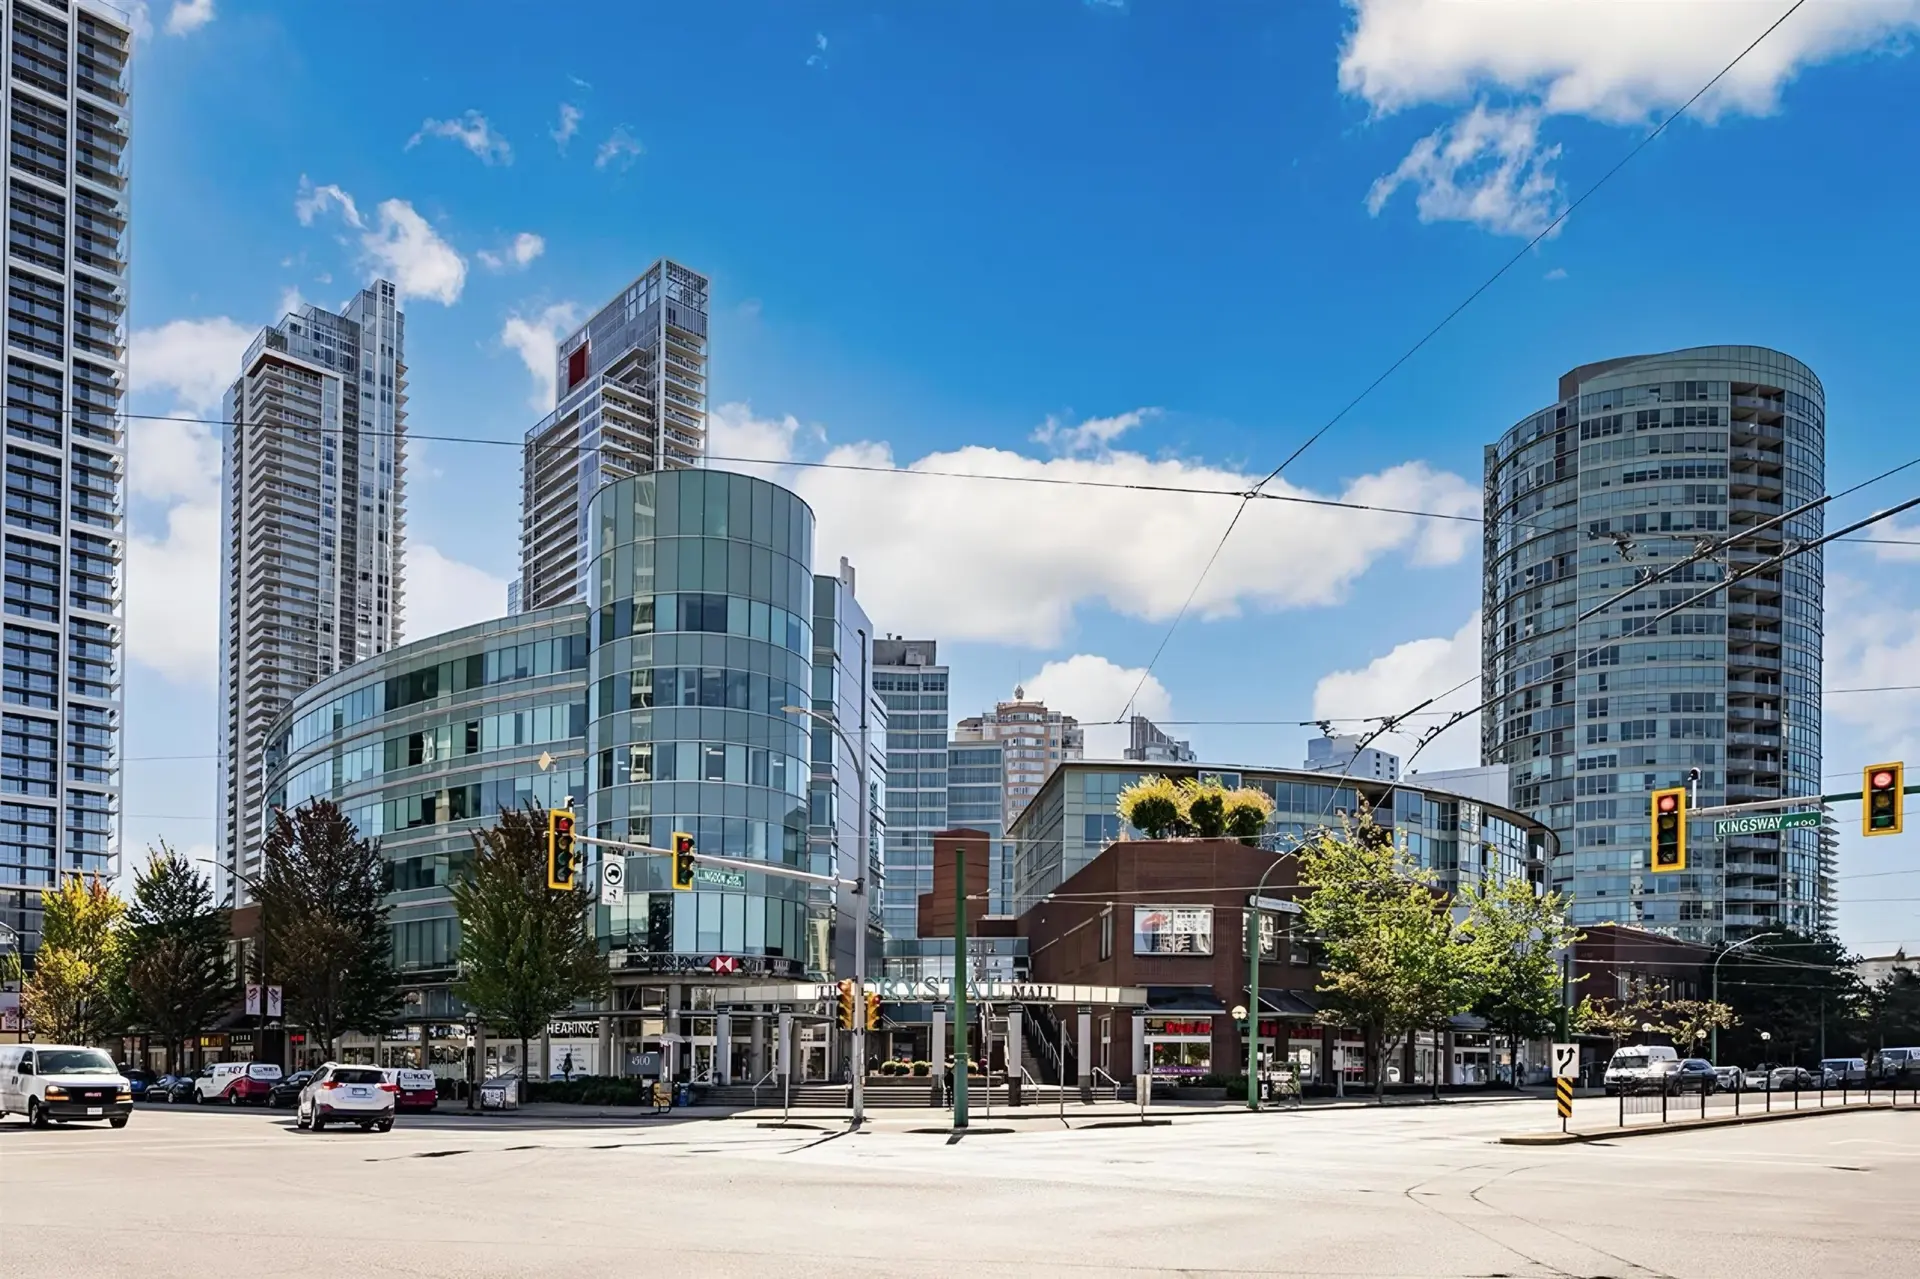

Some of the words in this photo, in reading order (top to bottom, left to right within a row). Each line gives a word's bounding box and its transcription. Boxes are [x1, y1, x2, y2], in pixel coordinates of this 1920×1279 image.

[1719, 817, 1782, 833] KINGSWAY
[1785, 819, 1815, 827] 4400
[817, 983, 837, 999] TH
[1012, 985, 1056, 1000] MALL
[547, 1022, 593, 1034] HEARING
